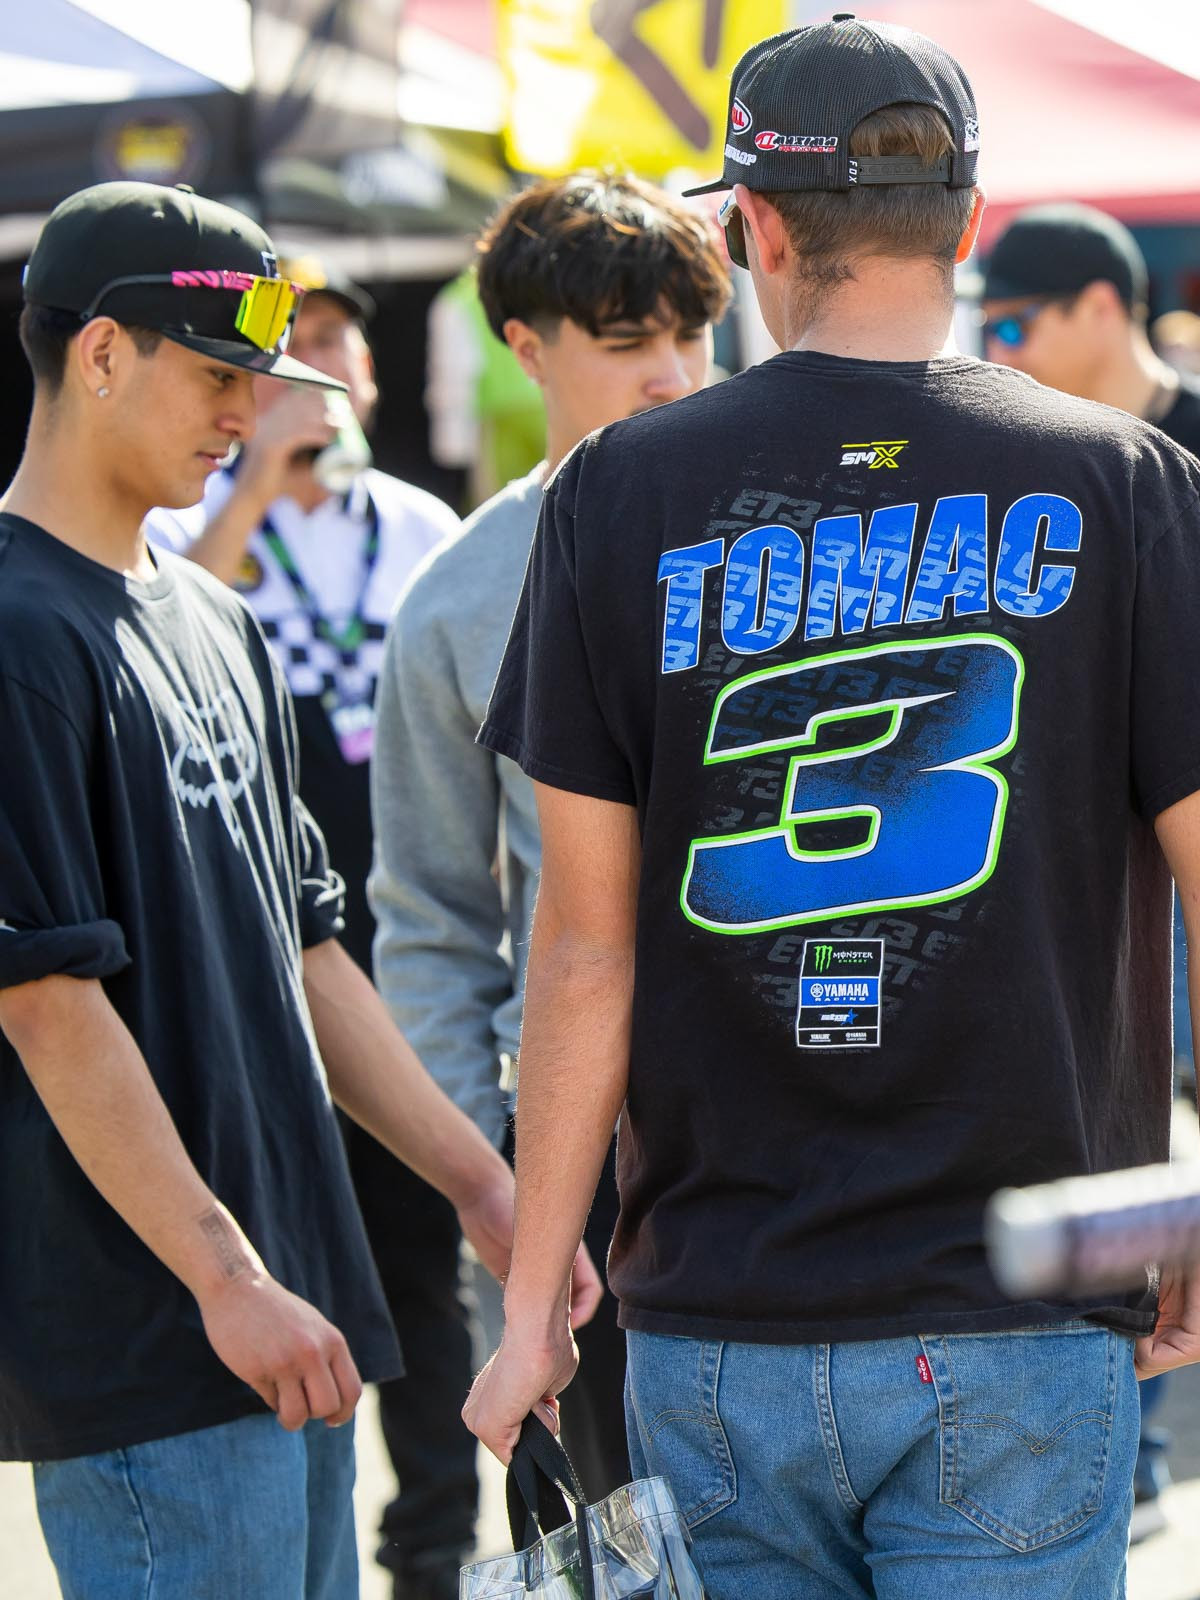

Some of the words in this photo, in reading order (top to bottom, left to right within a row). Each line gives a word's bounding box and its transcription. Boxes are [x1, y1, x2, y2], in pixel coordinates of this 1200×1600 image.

[848, 160, 858, 183] FOX
[839, 446, 905, 469] SMX
[656, 492, 1083, 675] TOMAC
[679, 632, 1026, 936] 3
[832, 950, 874, 960] MONSTER
[824, 983, 869, 997] YAMAHA
